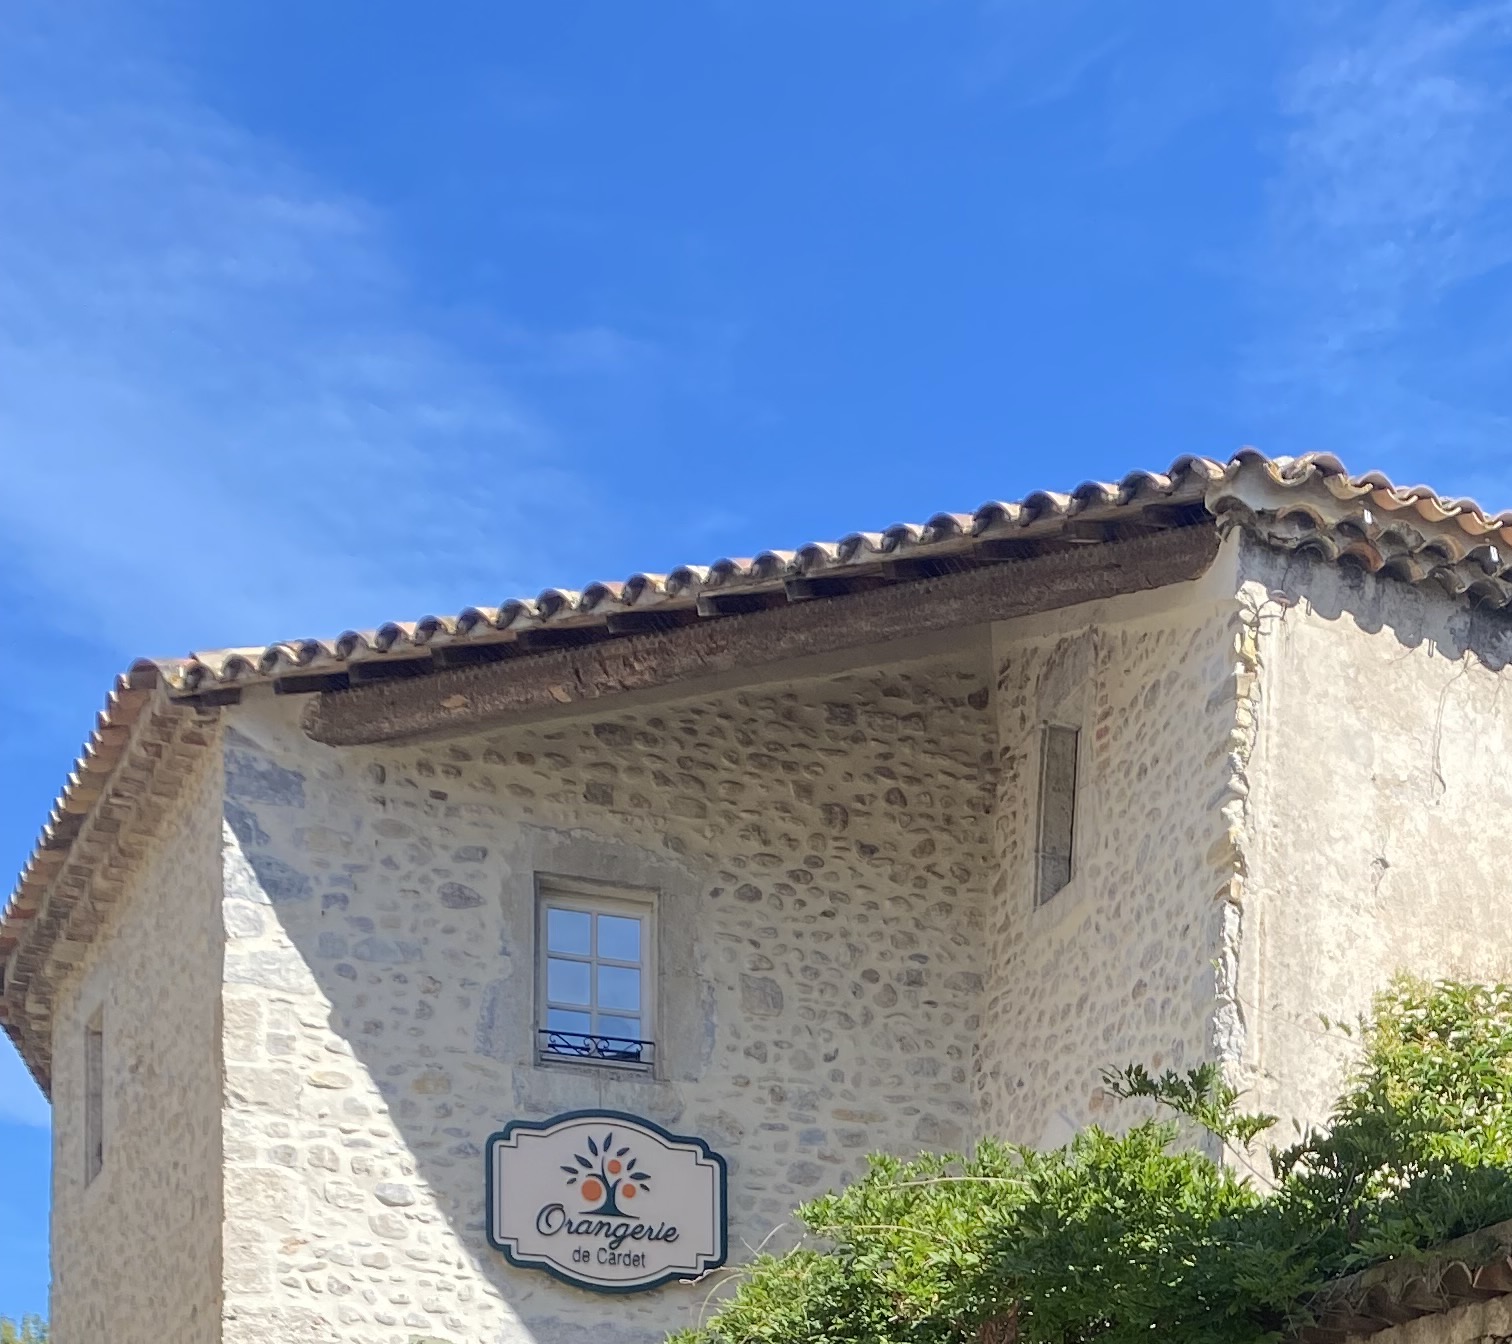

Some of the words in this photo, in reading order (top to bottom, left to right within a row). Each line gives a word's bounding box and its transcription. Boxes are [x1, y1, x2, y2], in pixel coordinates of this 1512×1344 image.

[536, 1203, 680, 1250] Orangerie
[572, 1246, 590, 1264] de
[597, 1247, 646, 1268] Cardet
